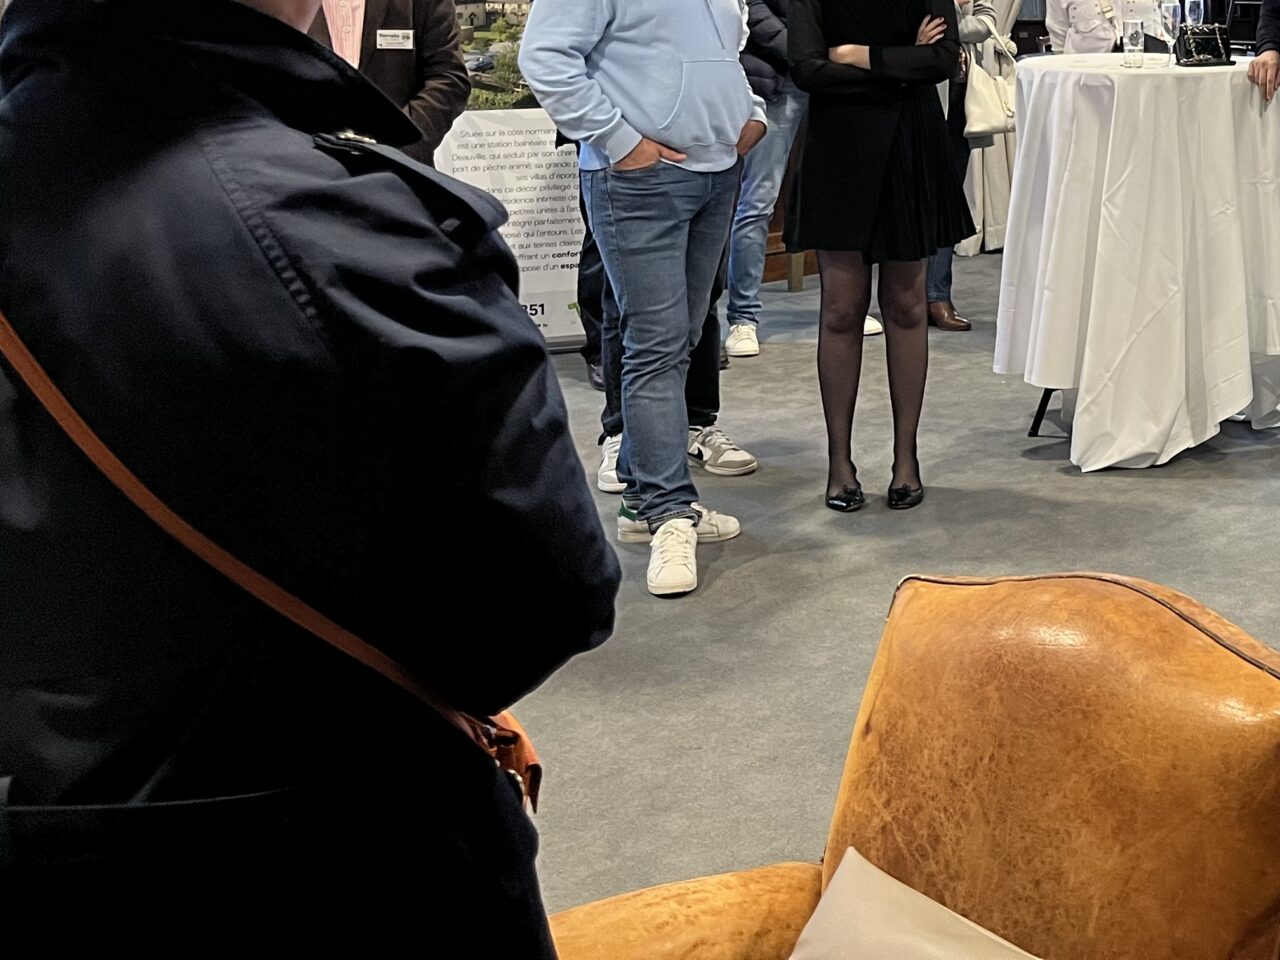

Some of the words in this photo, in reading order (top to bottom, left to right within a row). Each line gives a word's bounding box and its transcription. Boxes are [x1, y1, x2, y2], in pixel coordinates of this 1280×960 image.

[525, 127, 557, 136] norman
[549, 170, 578, 181] d'époq
[560, 262, 580, 271] espa
